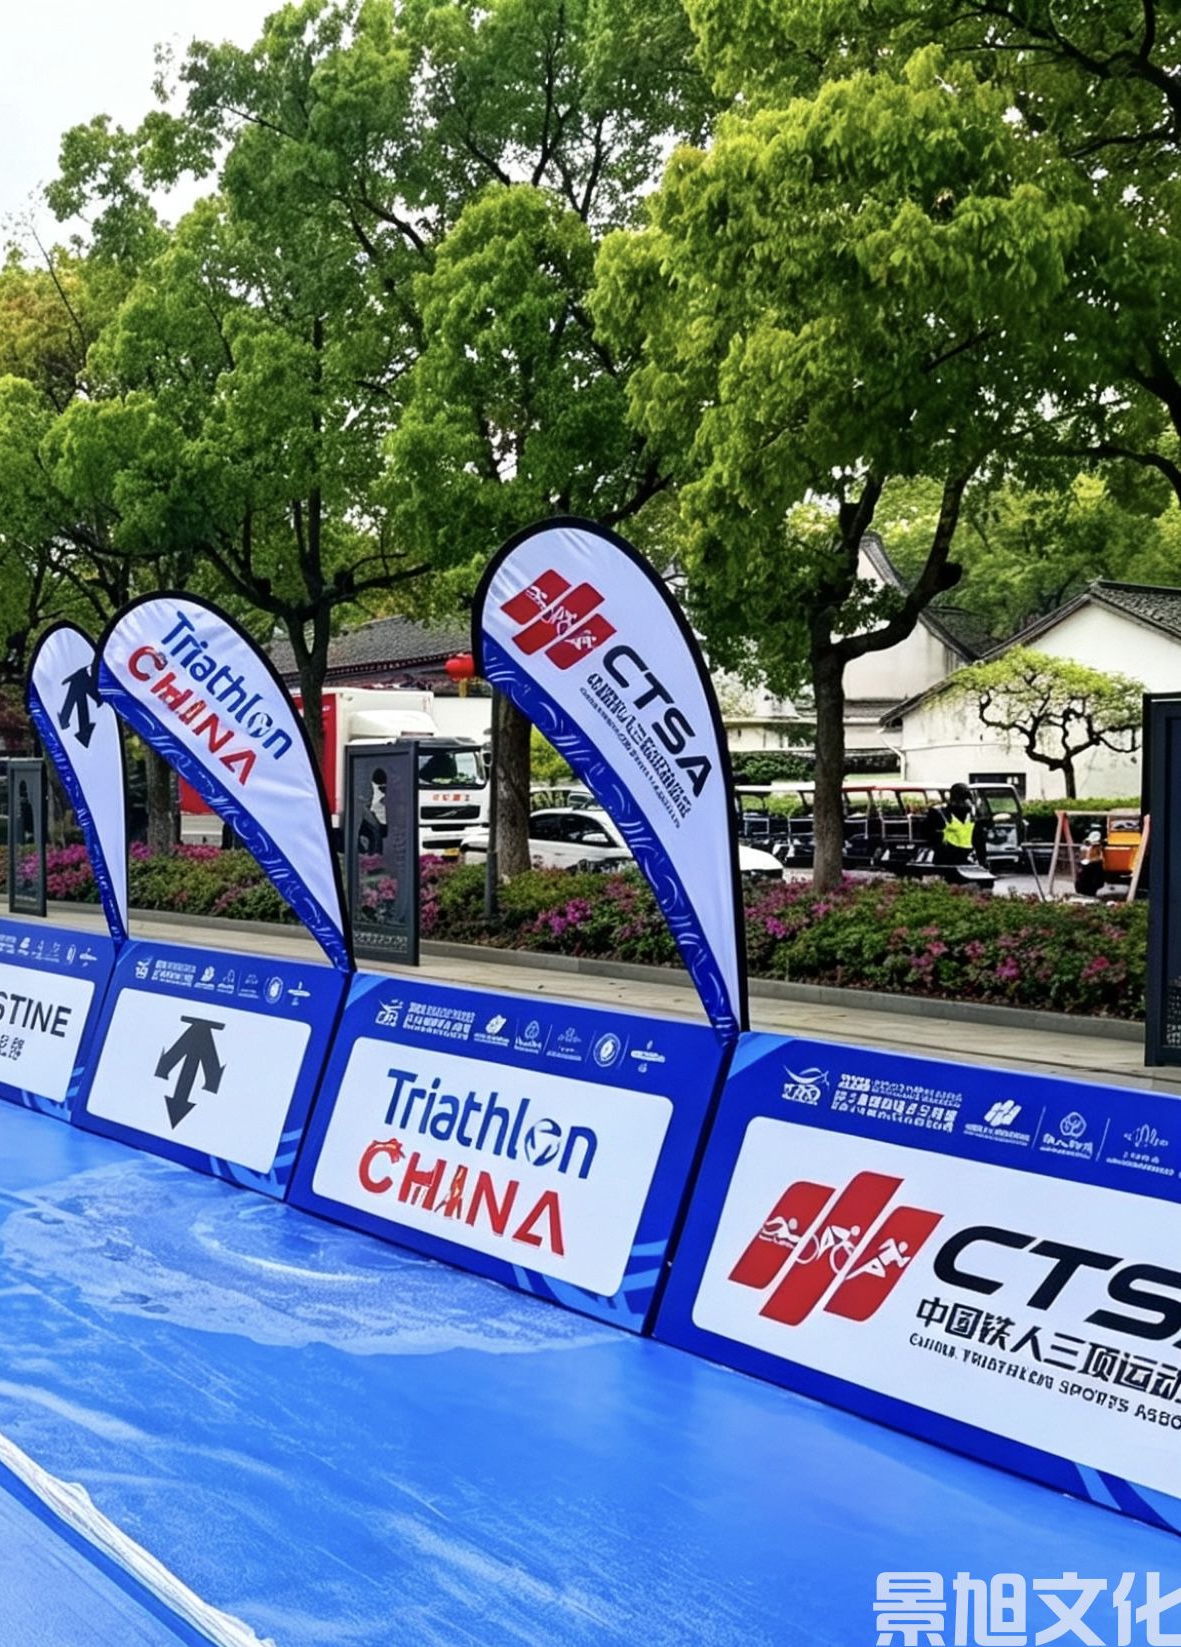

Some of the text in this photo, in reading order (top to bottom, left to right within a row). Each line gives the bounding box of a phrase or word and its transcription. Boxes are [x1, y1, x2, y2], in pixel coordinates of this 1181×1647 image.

[128, 644, 258, 786] CHINA
[161, 610, 293, 761] Triathlon
[603, 645, 712, 798] CTSA
[384, 1068, 598, 1180] Triathlon
[358, 1138, 565, 1258] CHINA
[933, 1225, 1181, 1348] CTS
